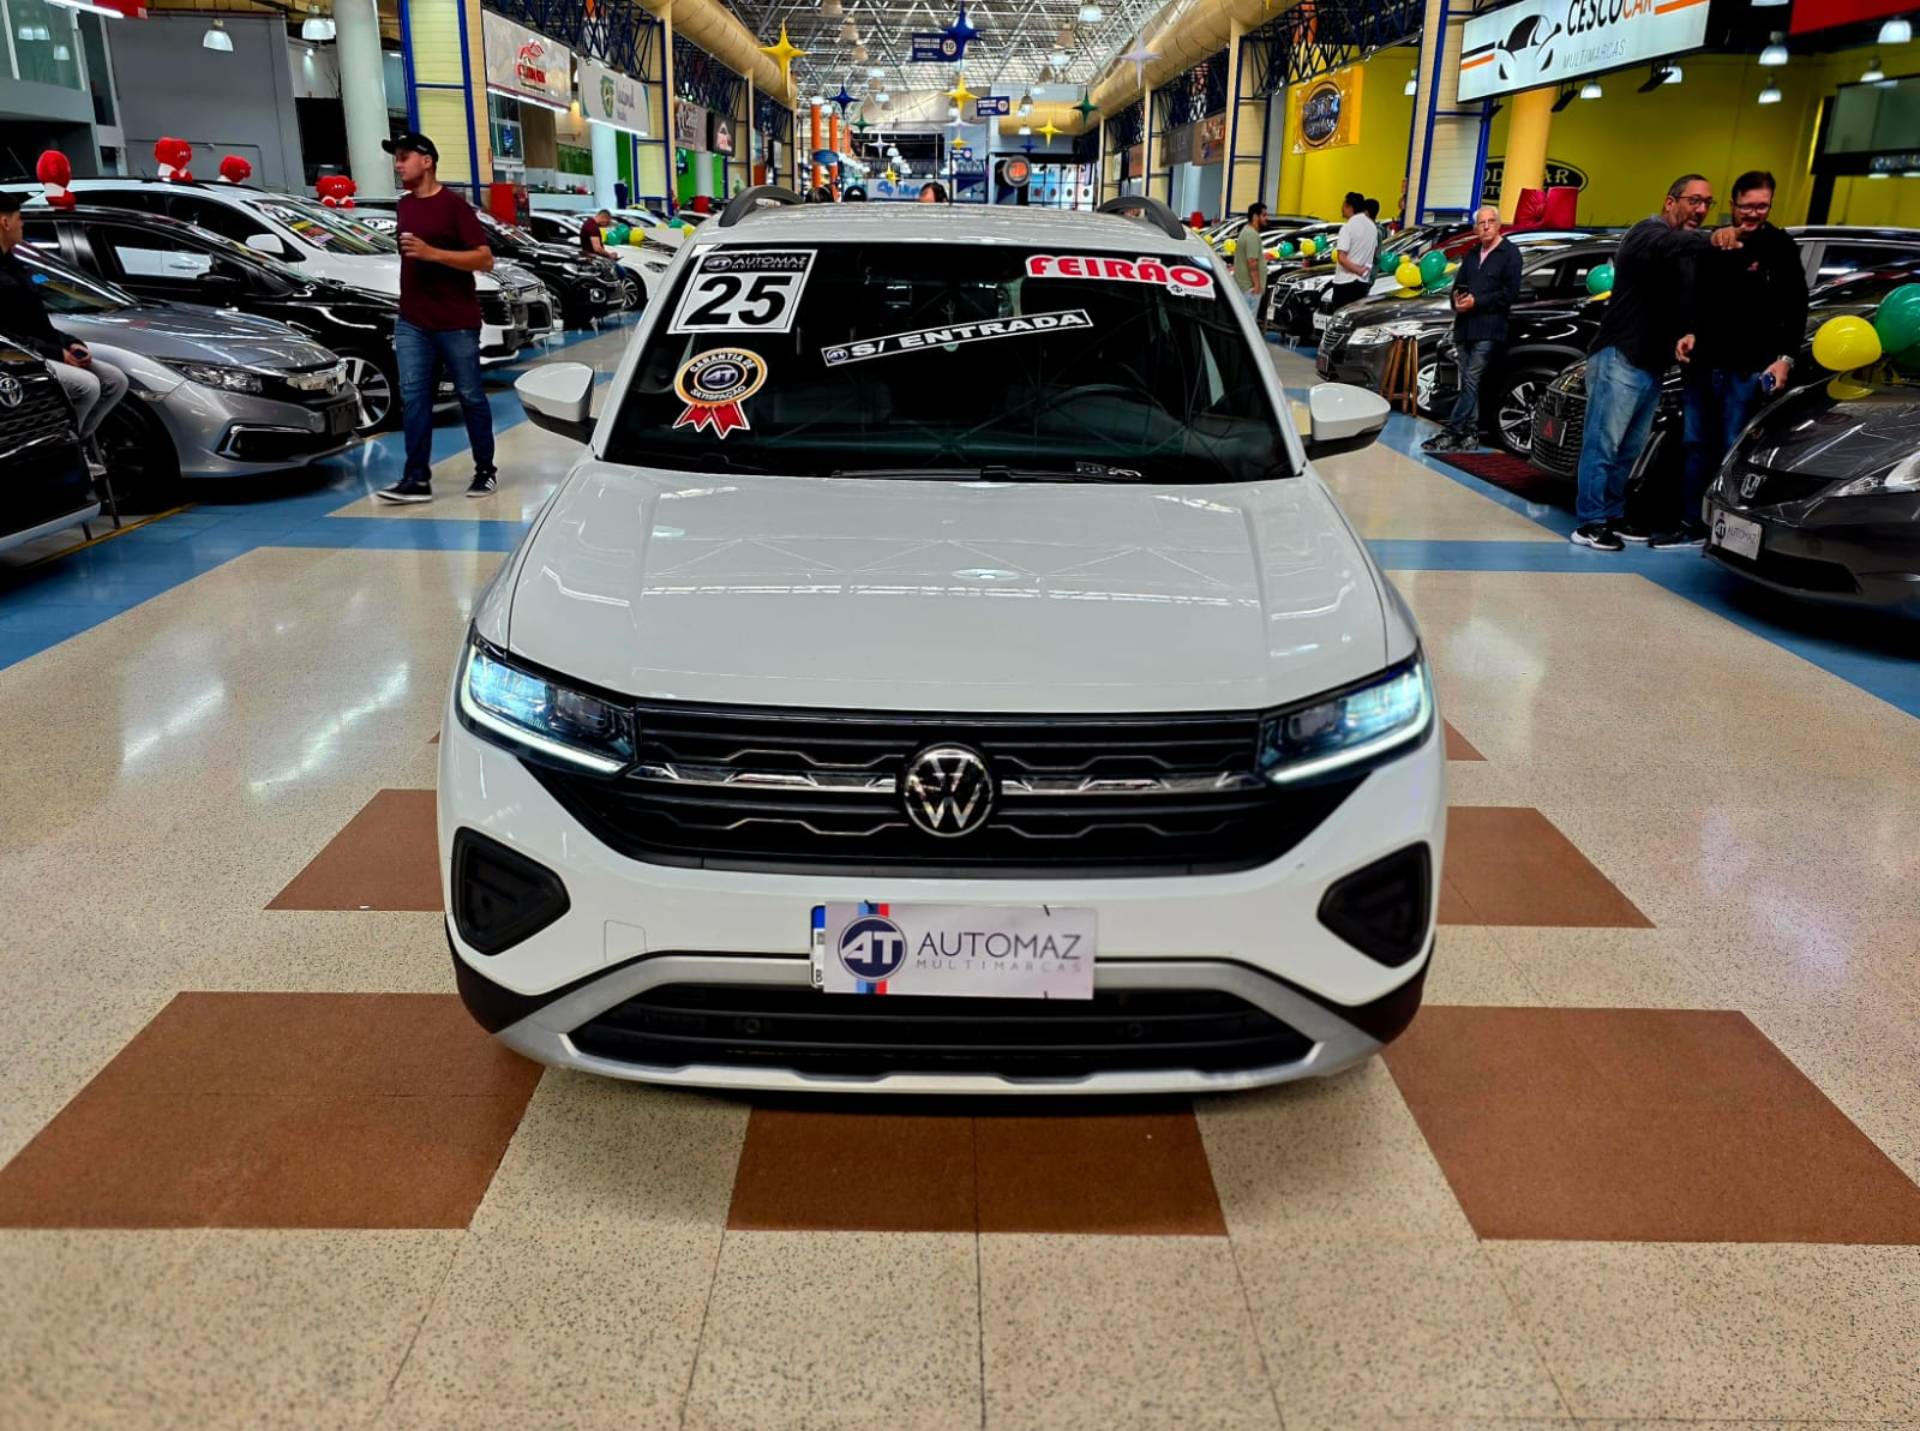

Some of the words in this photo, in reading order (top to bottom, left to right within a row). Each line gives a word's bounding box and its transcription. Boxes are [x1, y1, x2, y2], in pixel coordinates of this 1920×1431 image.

[734, 256, 807, 265] AUTOMAZ
[1030, 256, 1210, 287] FEIRÃO
[684, 275, 792, 325] 25
[851, 340, 885, 356] S/
[899, 314, 1085, 348] ENTRADA
[690, 353, 744, 372] GARANTIA
[841, 931, 902, 964] AT
[917, 931, 1081, 959] AUTOMAZ
[916, 959, 1081, 972] MULTIMARCAS
